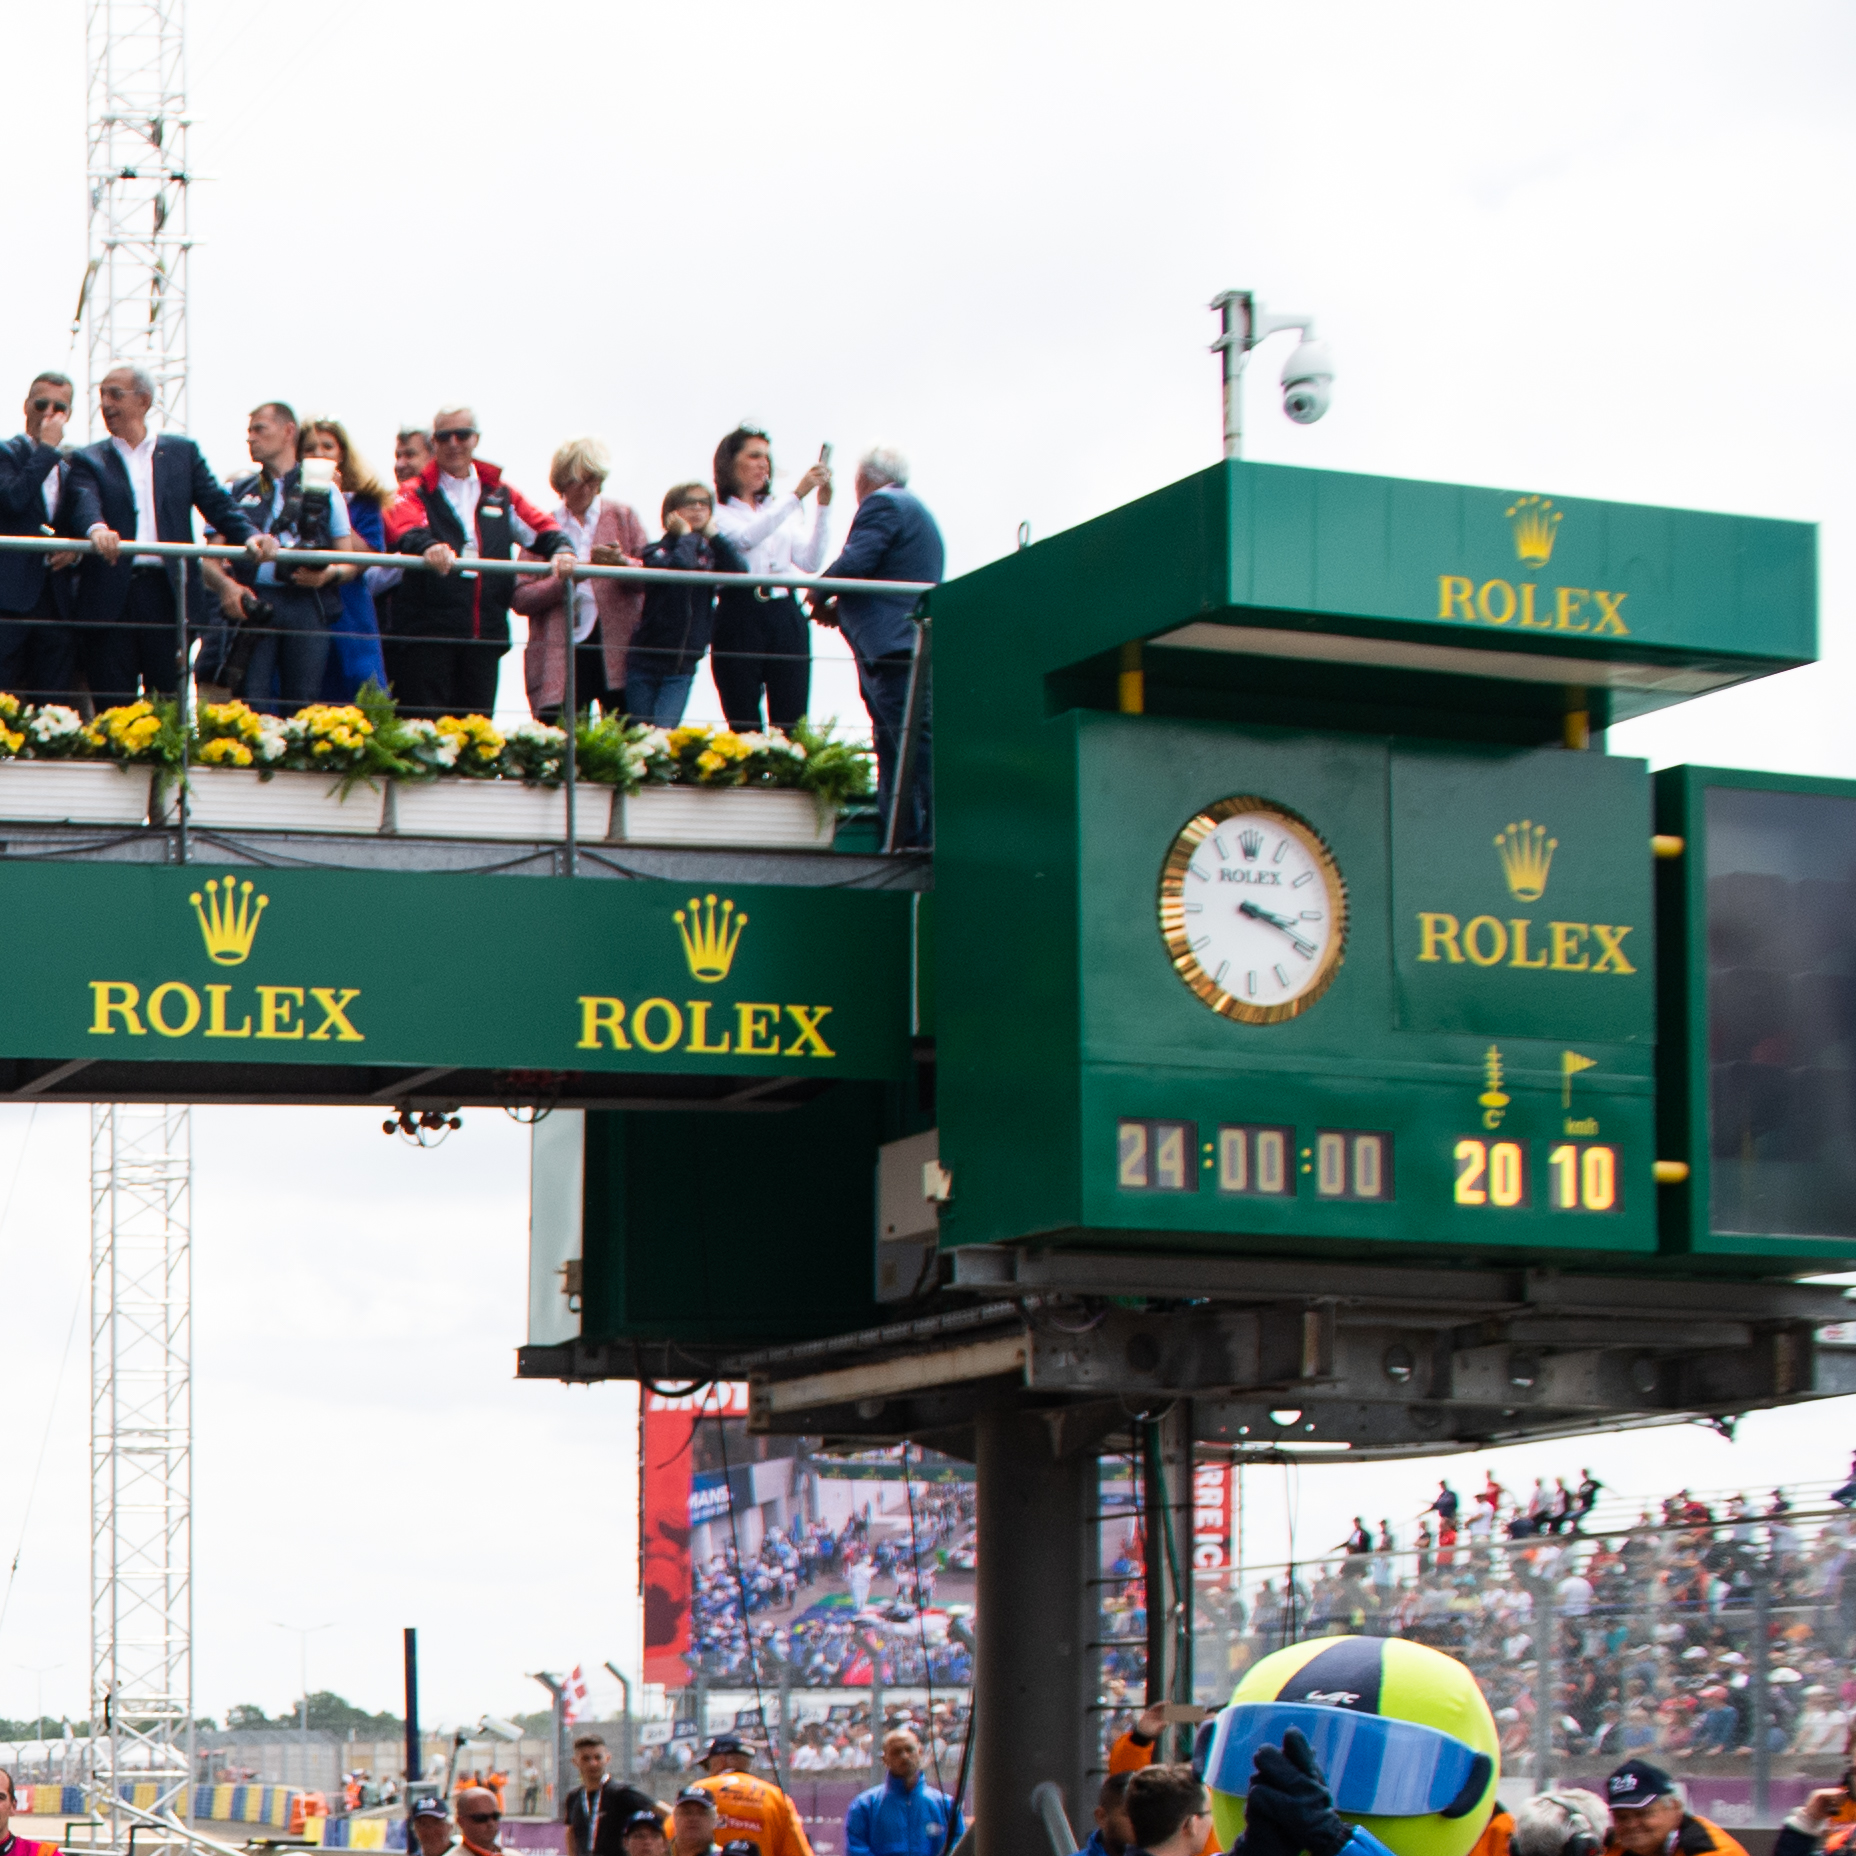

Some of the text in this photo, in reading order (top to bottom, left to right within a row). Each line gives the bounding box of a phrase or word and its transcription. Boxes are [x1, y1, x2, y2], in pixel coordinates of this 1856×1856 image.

[1438, 574, 1629, 636] ROLEX
[1219, 867, 1283, 886] ROLEX
[1417, 911, 1636, 976] ROLEX
[88, 981, 365, 1043] ROLEX
[577, 996, 835, 1058] ROLEX
[1454, 1139, 1524, 1208] 20
[1550, 1142, 1617, 1211] 10
